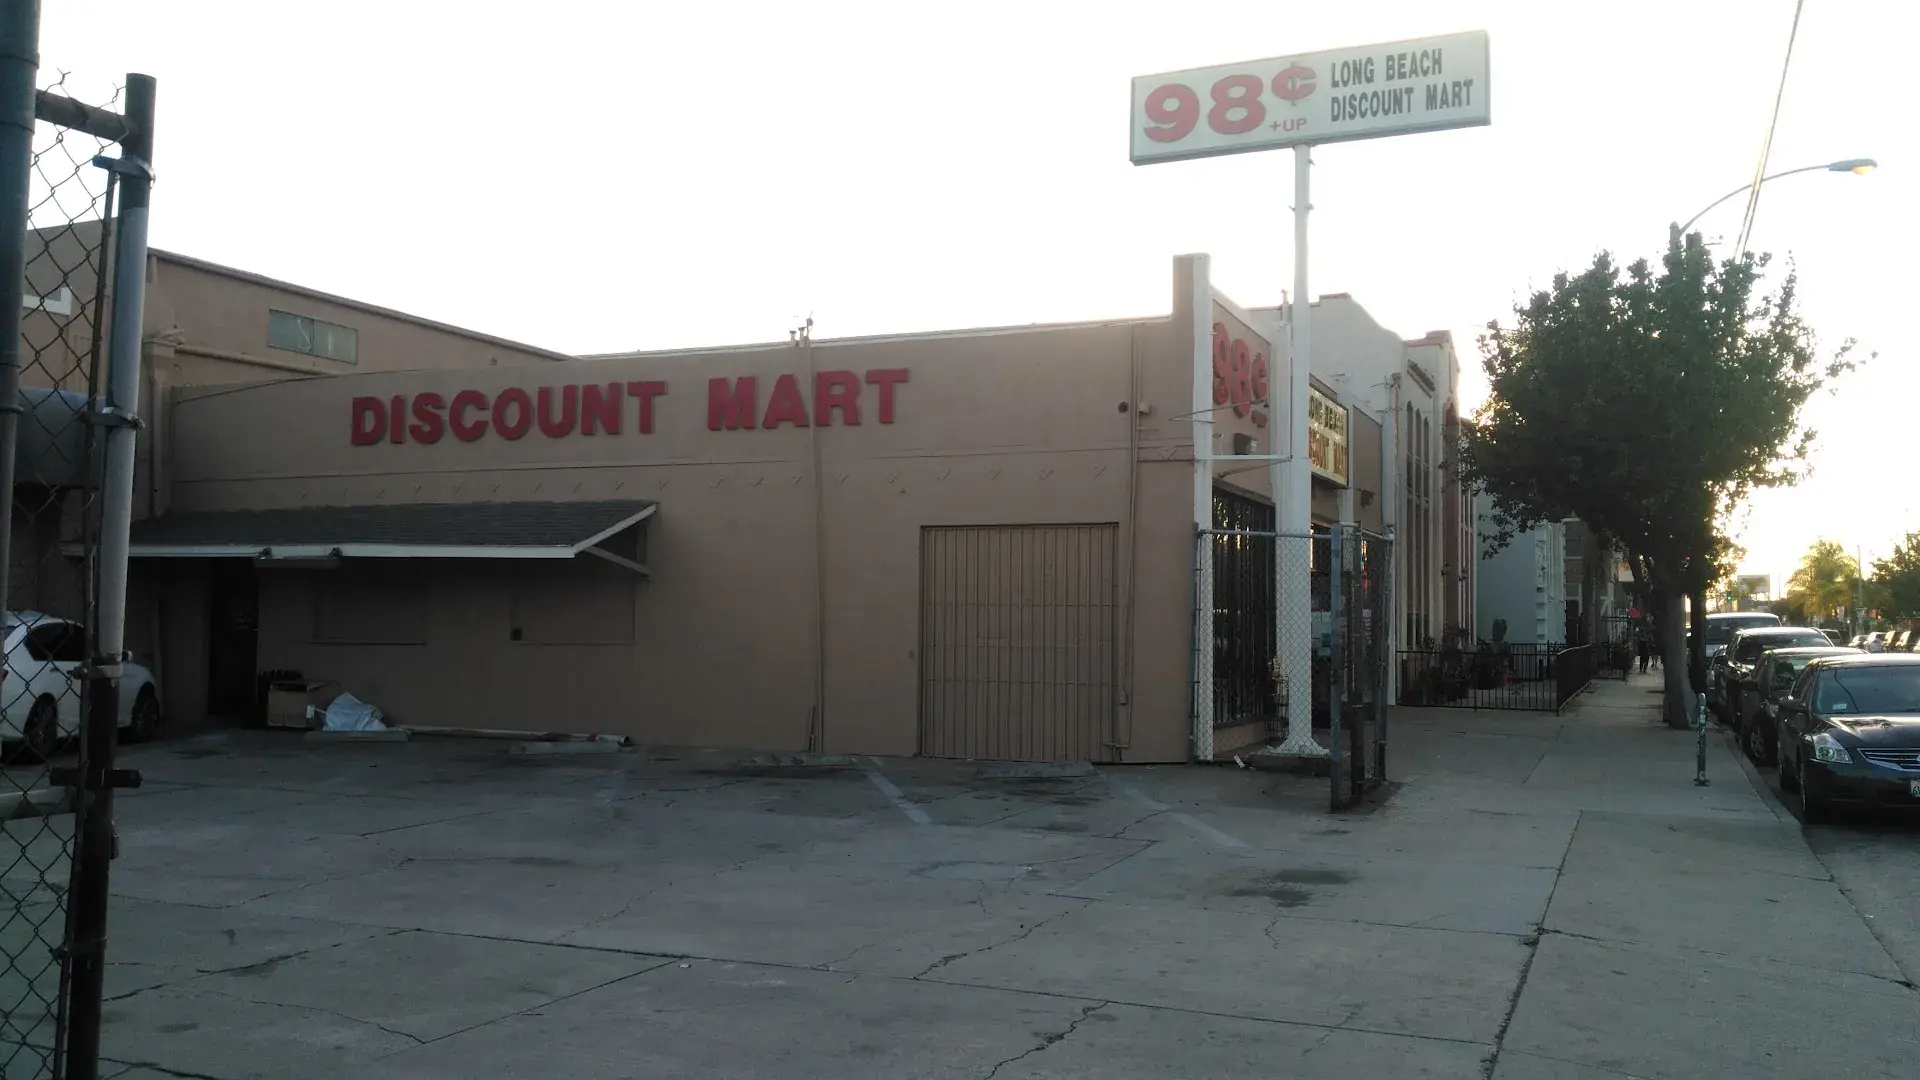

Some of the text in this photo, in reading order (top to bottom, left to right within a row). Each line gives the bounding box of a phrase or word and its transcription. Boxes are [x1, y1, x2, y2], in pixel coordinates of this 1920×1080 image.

[1330, 48, 1443, 88] LONG BEACH
[1330, 78, 1474, 122] DISCOUNT MART
[1269, 117, 1308, 133] +UP
[349, 367, 910, 447] DISCOUNT MART
